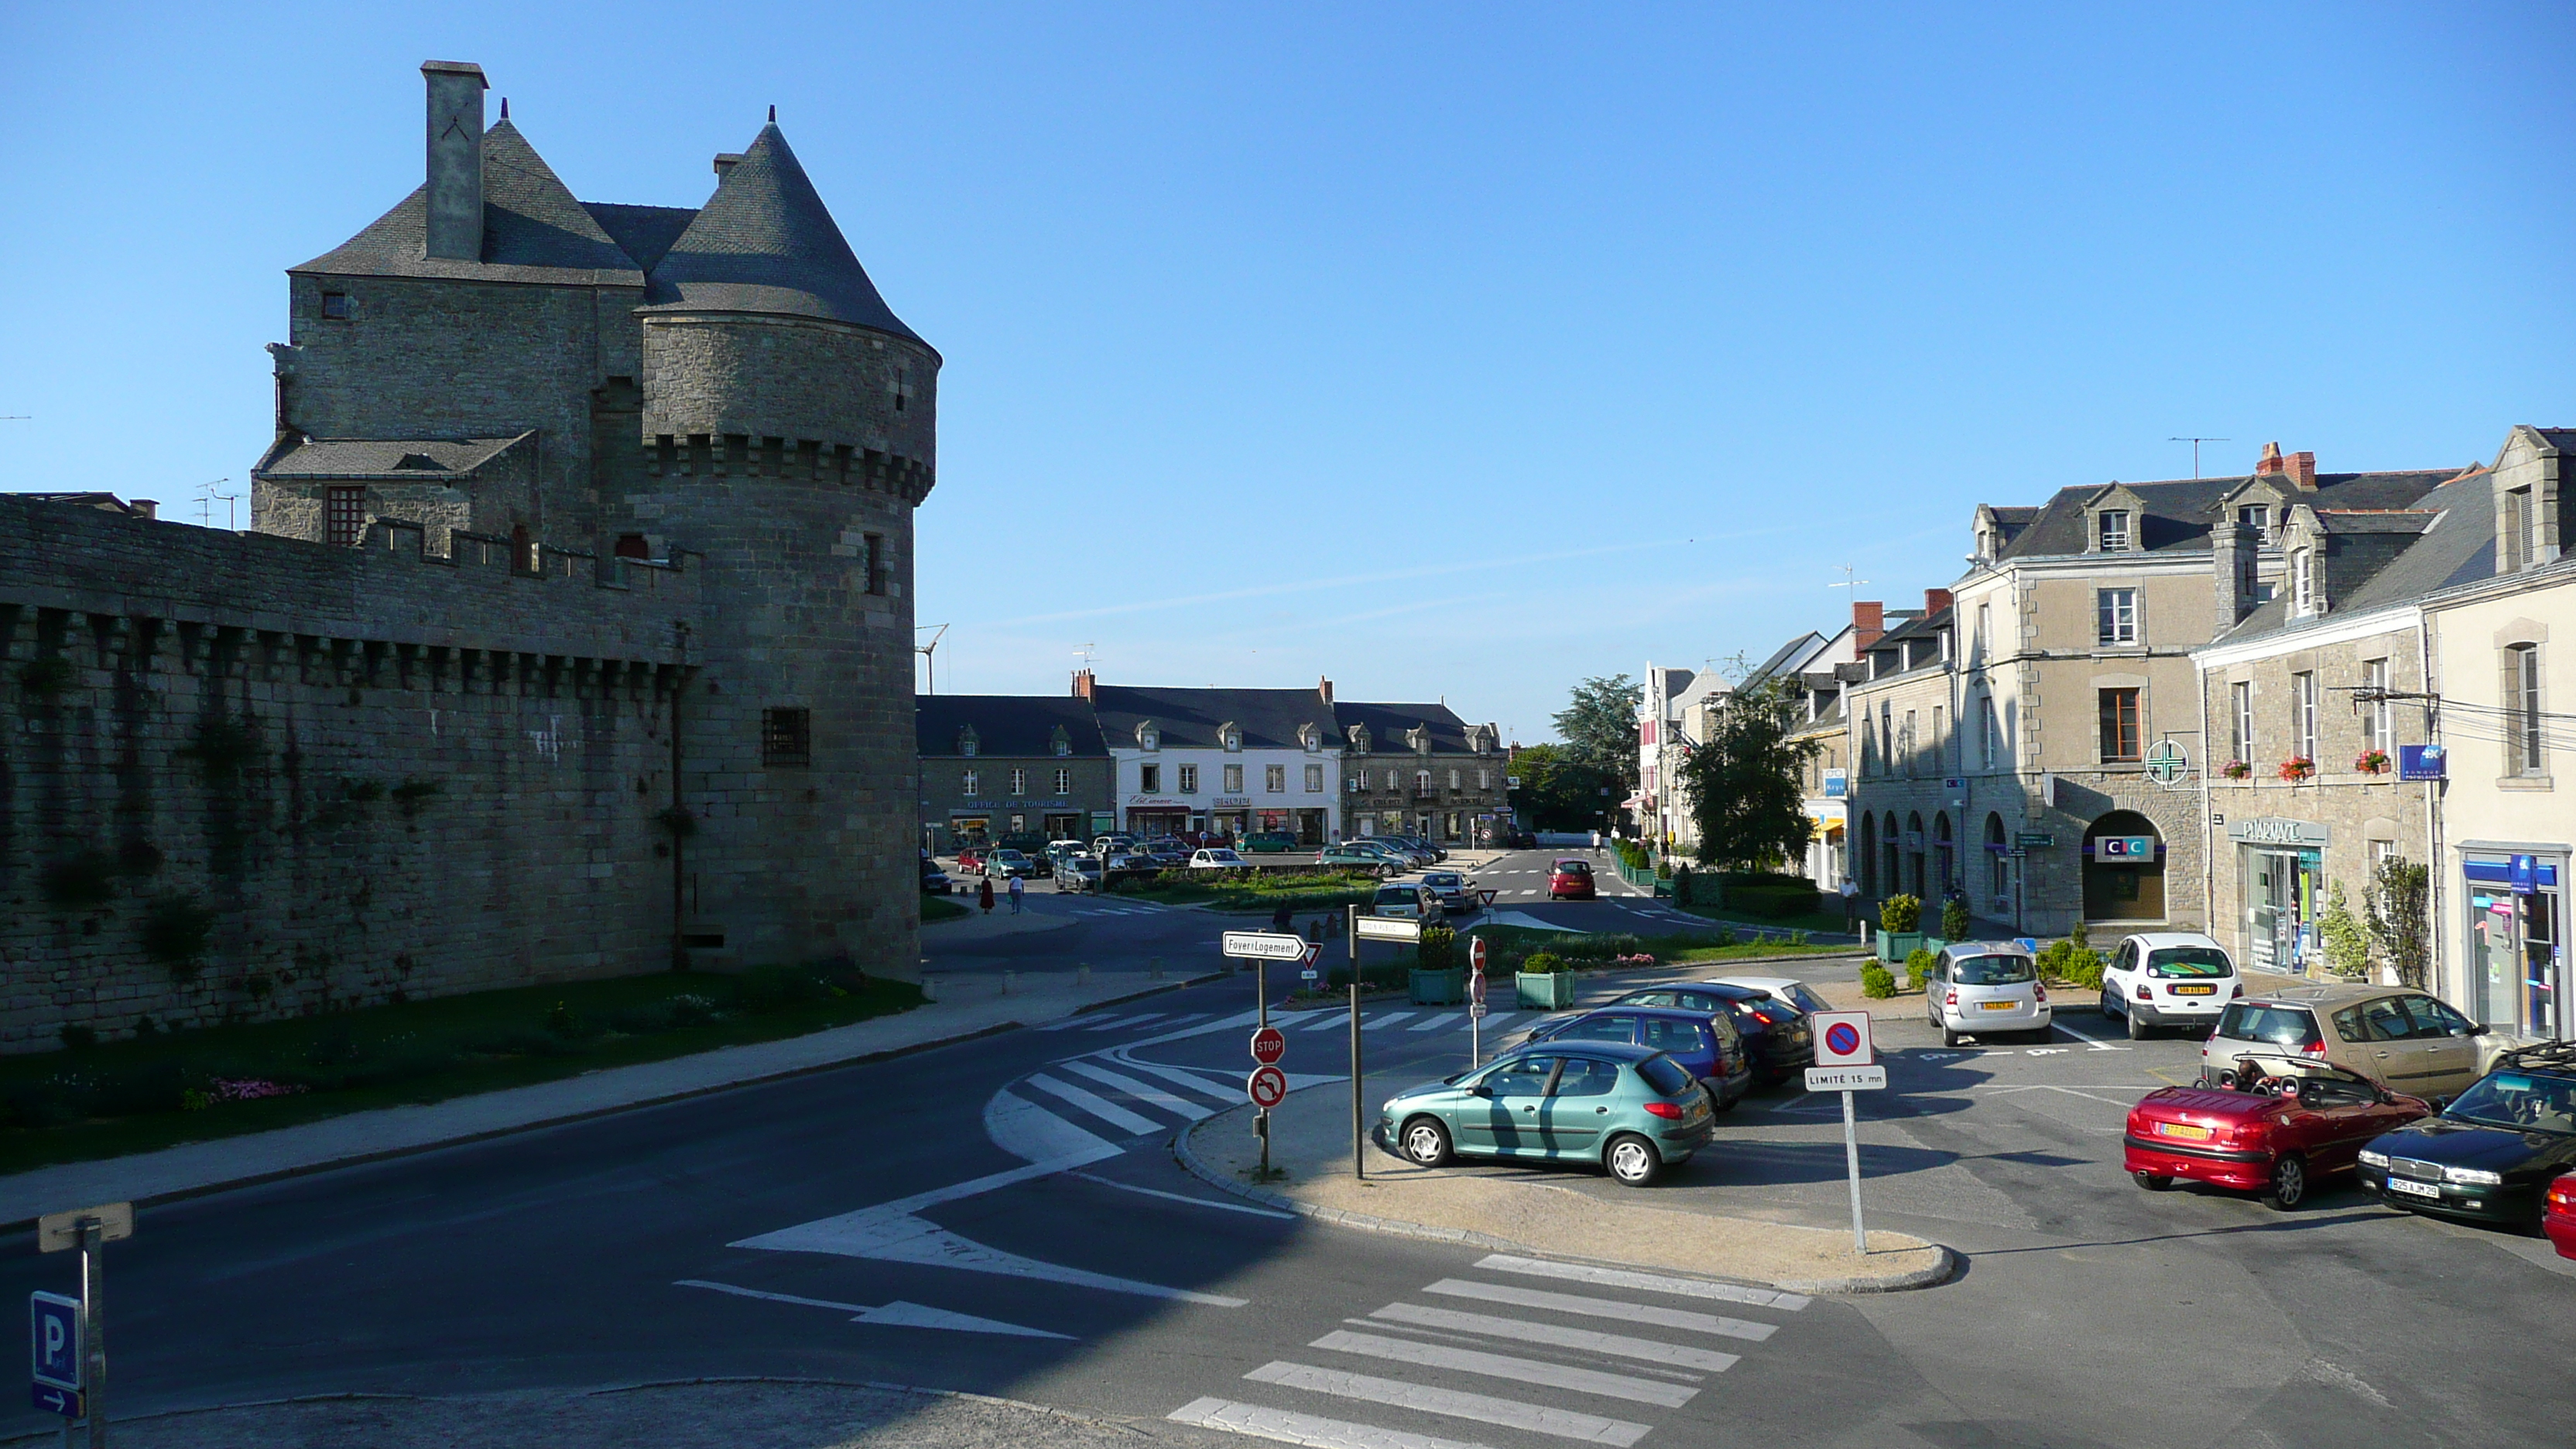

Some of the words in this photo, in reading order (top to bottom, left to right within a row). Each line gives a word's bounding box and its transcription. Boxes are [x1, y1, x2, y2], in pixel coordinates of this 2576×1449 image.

[1827, 783, 1844, 792] Krys
[2108, 841, 2142, 853] CIC
[1379, 923, 1396, 932] PUBLIC
[1257, 1040, 1282, 1052] STOP
[1810, 1074, 1845, 1084] LIMITÉ
[1851, 1075, 1863, 1084] 15
[2410, 1184, 2424, 1194] AJM
[2426, 1187, 2437, 1197] 29
[45, 1314, 65, 1365] P
